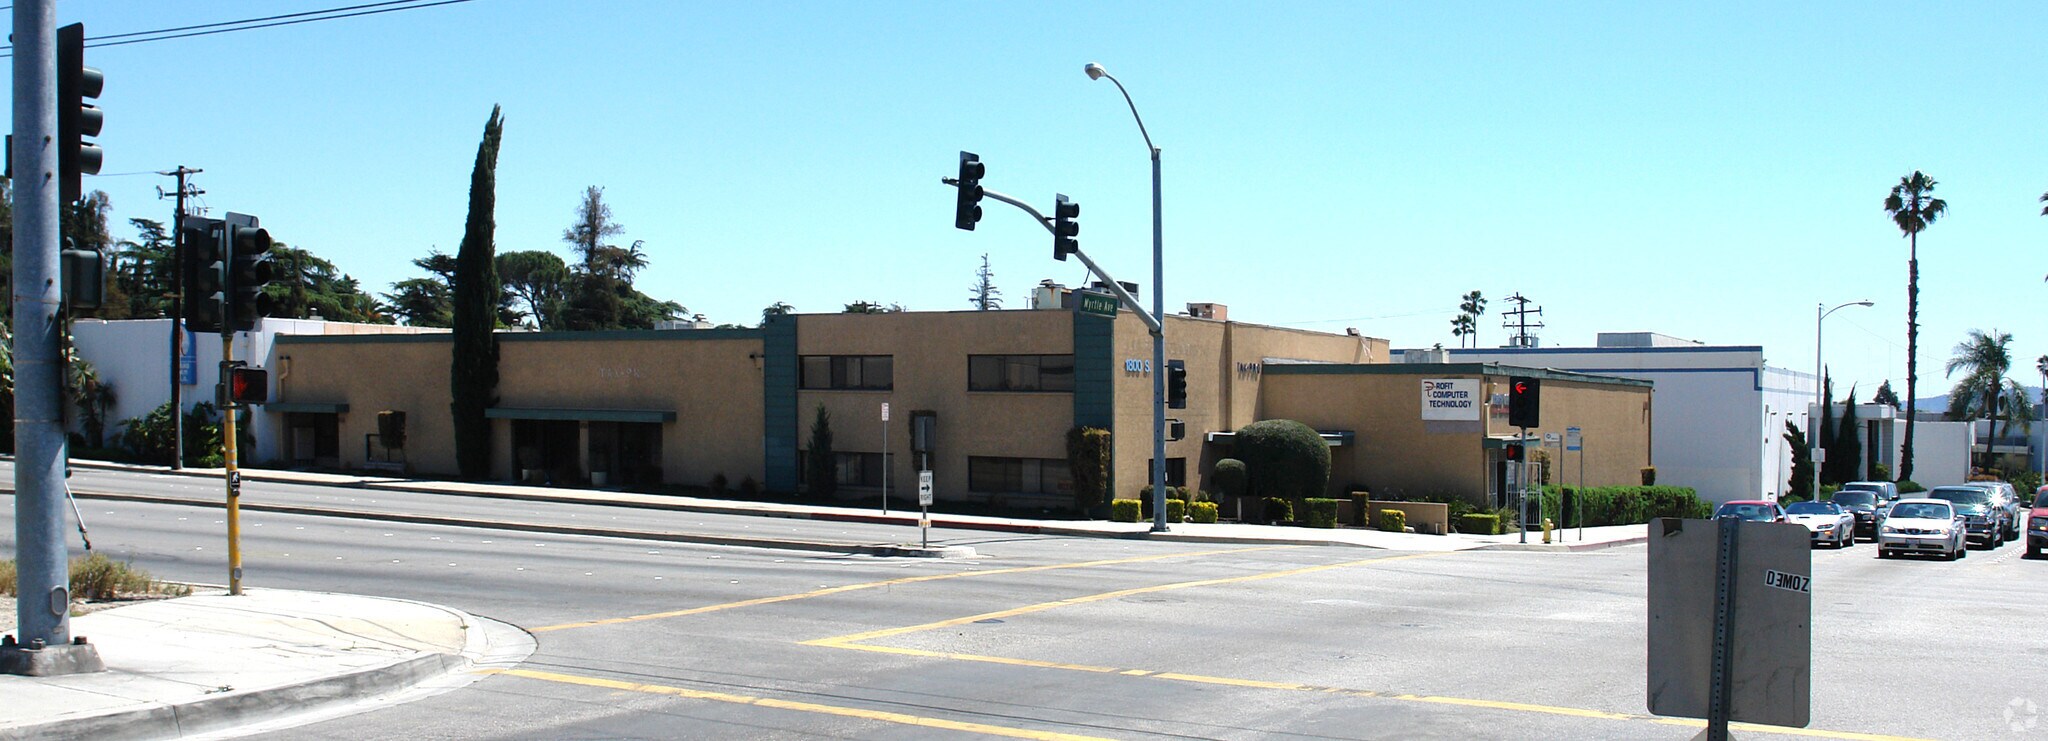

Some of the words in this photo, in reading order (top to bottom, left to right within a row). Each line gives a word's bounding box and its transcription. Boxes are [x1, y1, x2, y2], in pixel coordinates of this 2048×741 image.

[1084, 298, 1103, 311] Myrtle
[1103, 301, 1114, 312] Ave
[1125, 359, 1143, 372] 1800
[1432, 391, 1469, 399] COMPUTER
[1429, 400, 1472, 408] TECHNOLOGY
[920, 493, 932, 501] RIGHT
